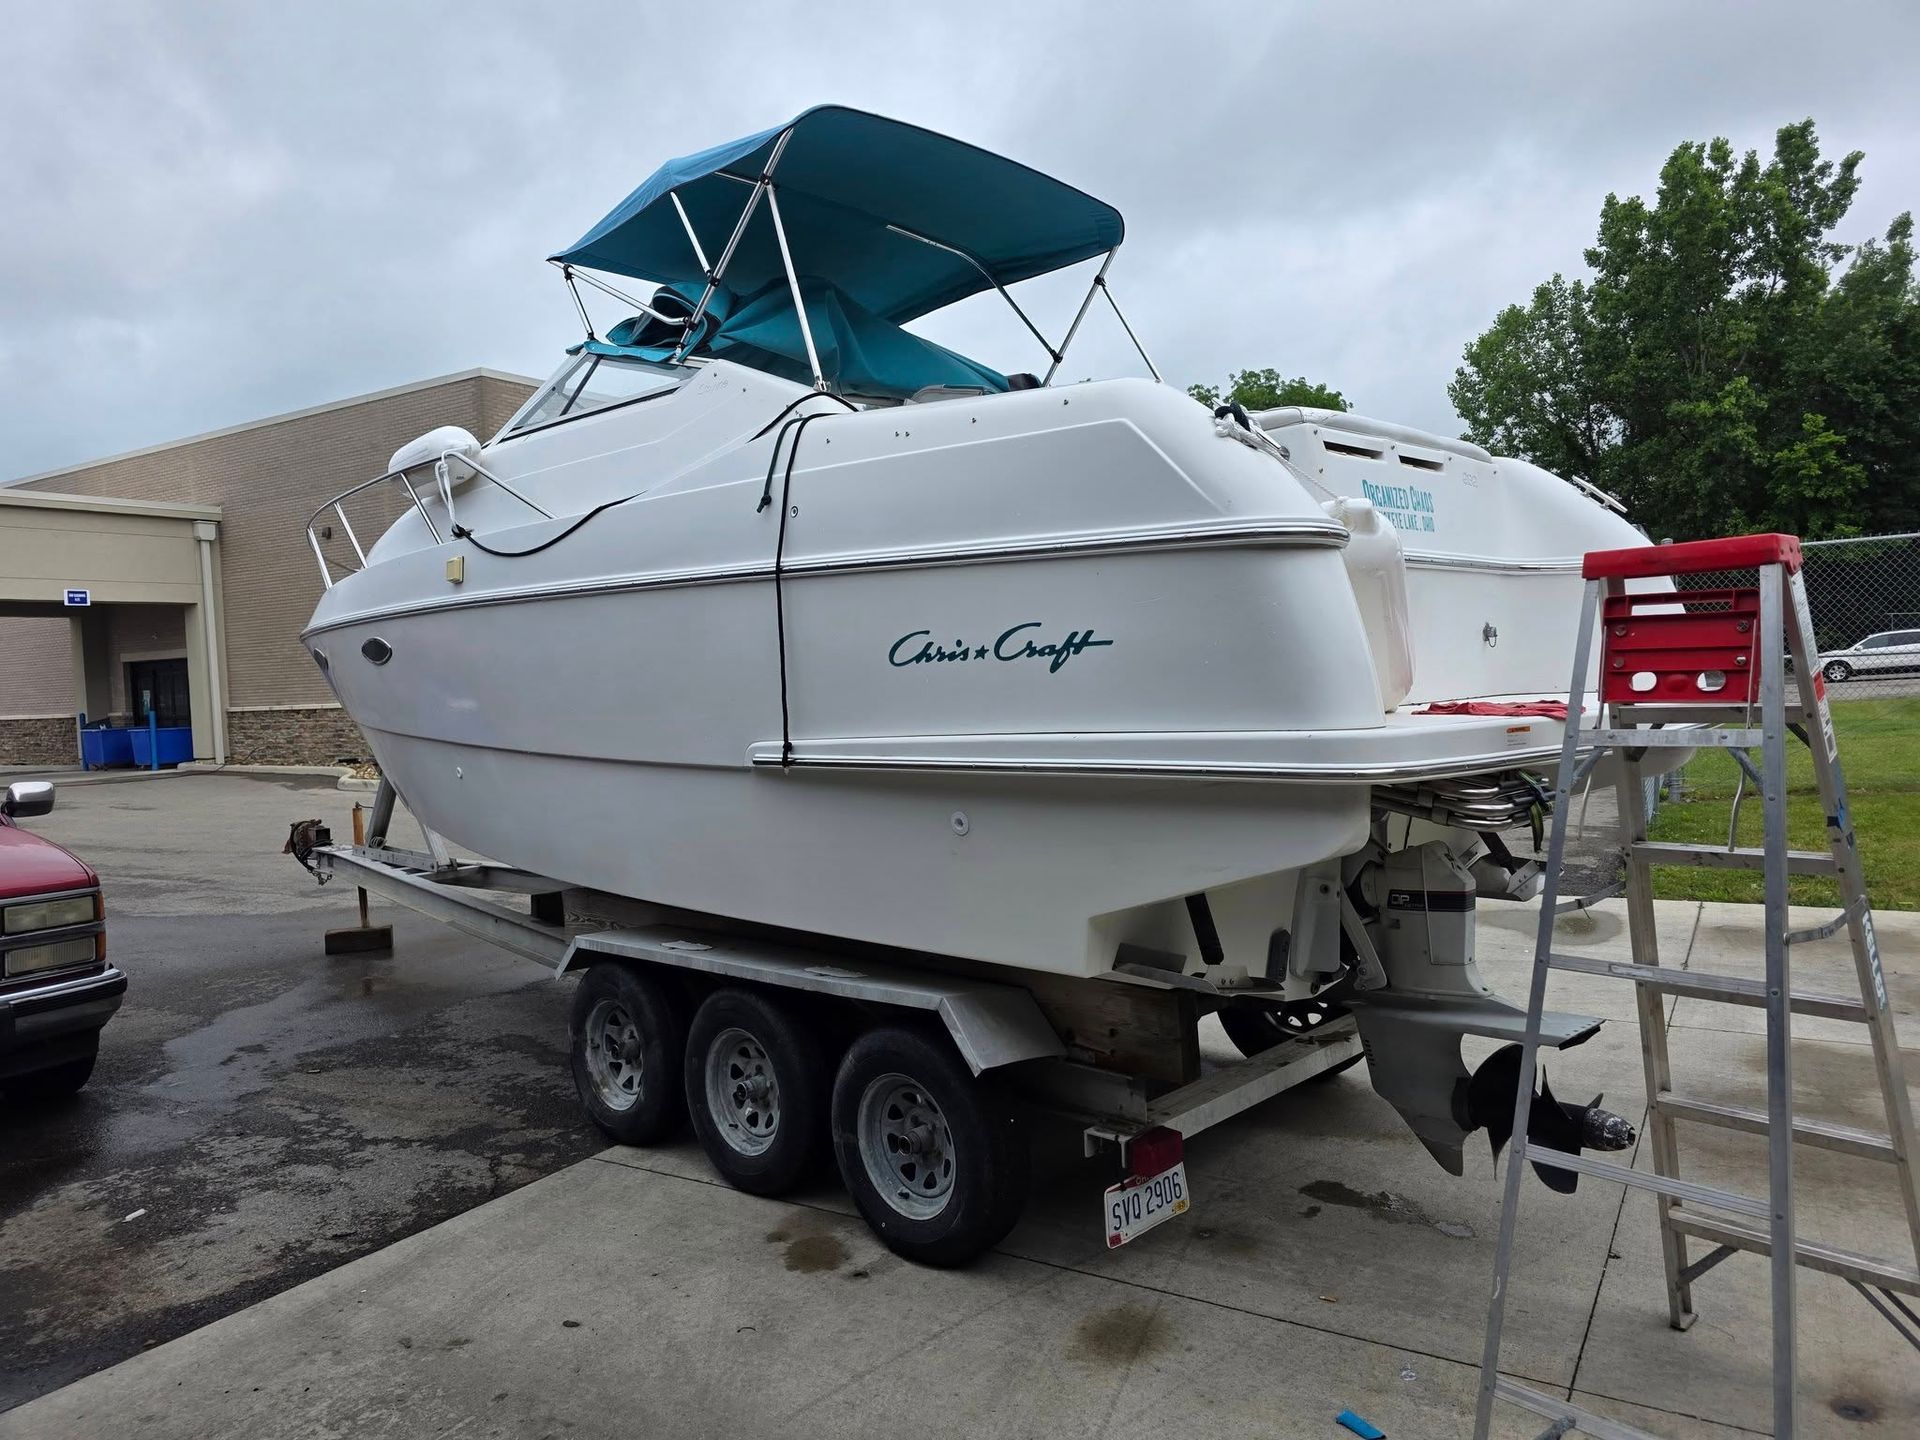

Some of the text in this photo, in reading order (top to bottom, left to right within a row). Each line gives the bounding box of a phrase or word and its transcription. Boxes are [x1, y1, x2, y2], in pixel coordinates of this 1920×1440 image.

[1361, 479, 1435, 513] ORGANIZED CHAOS
[889, 622, 1114, 674] Chris Craft
[1862, 910, 1886, 1010] KELLER
[1112, 1171, 1182, 1231] SVQ 2906
